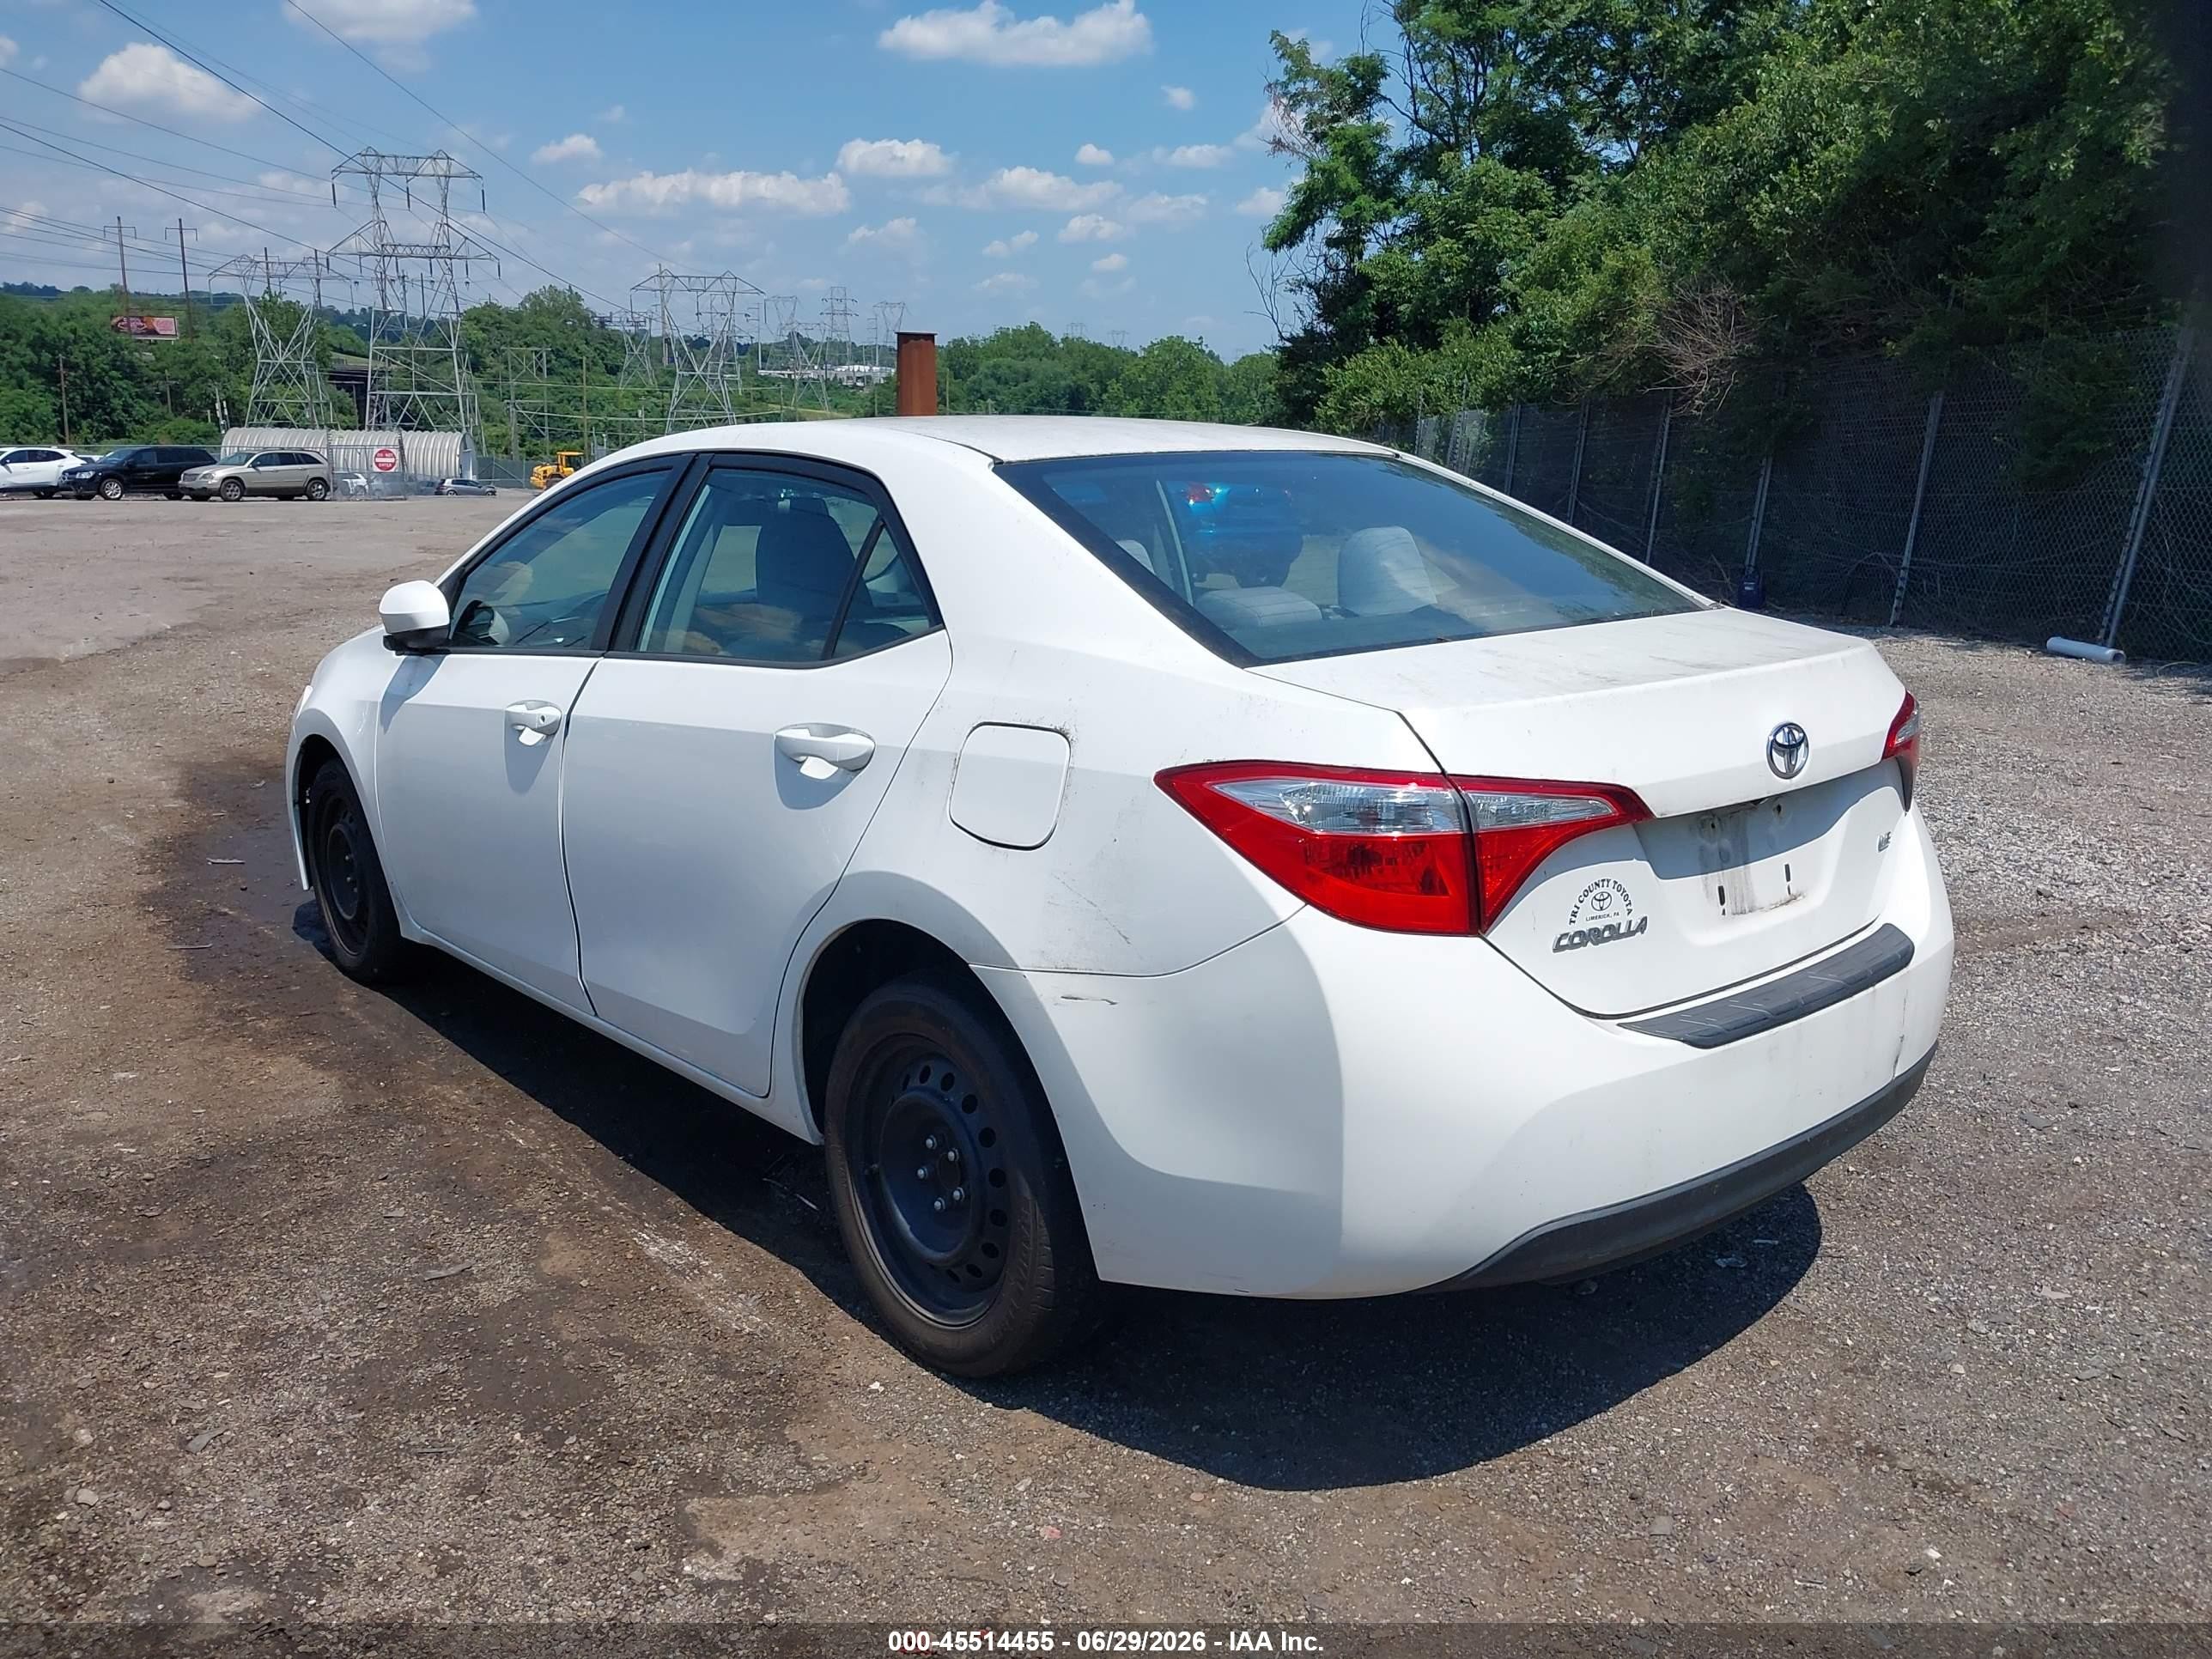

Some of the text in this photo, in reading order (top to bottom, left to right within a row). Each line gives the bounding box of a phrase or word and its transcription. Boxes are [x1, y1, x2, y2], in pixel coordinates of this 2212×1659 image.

[1569, 878, 1633, 926] TRI COUNTY TOYOTA
[1552, 915, 1649, 953] COROLLA
